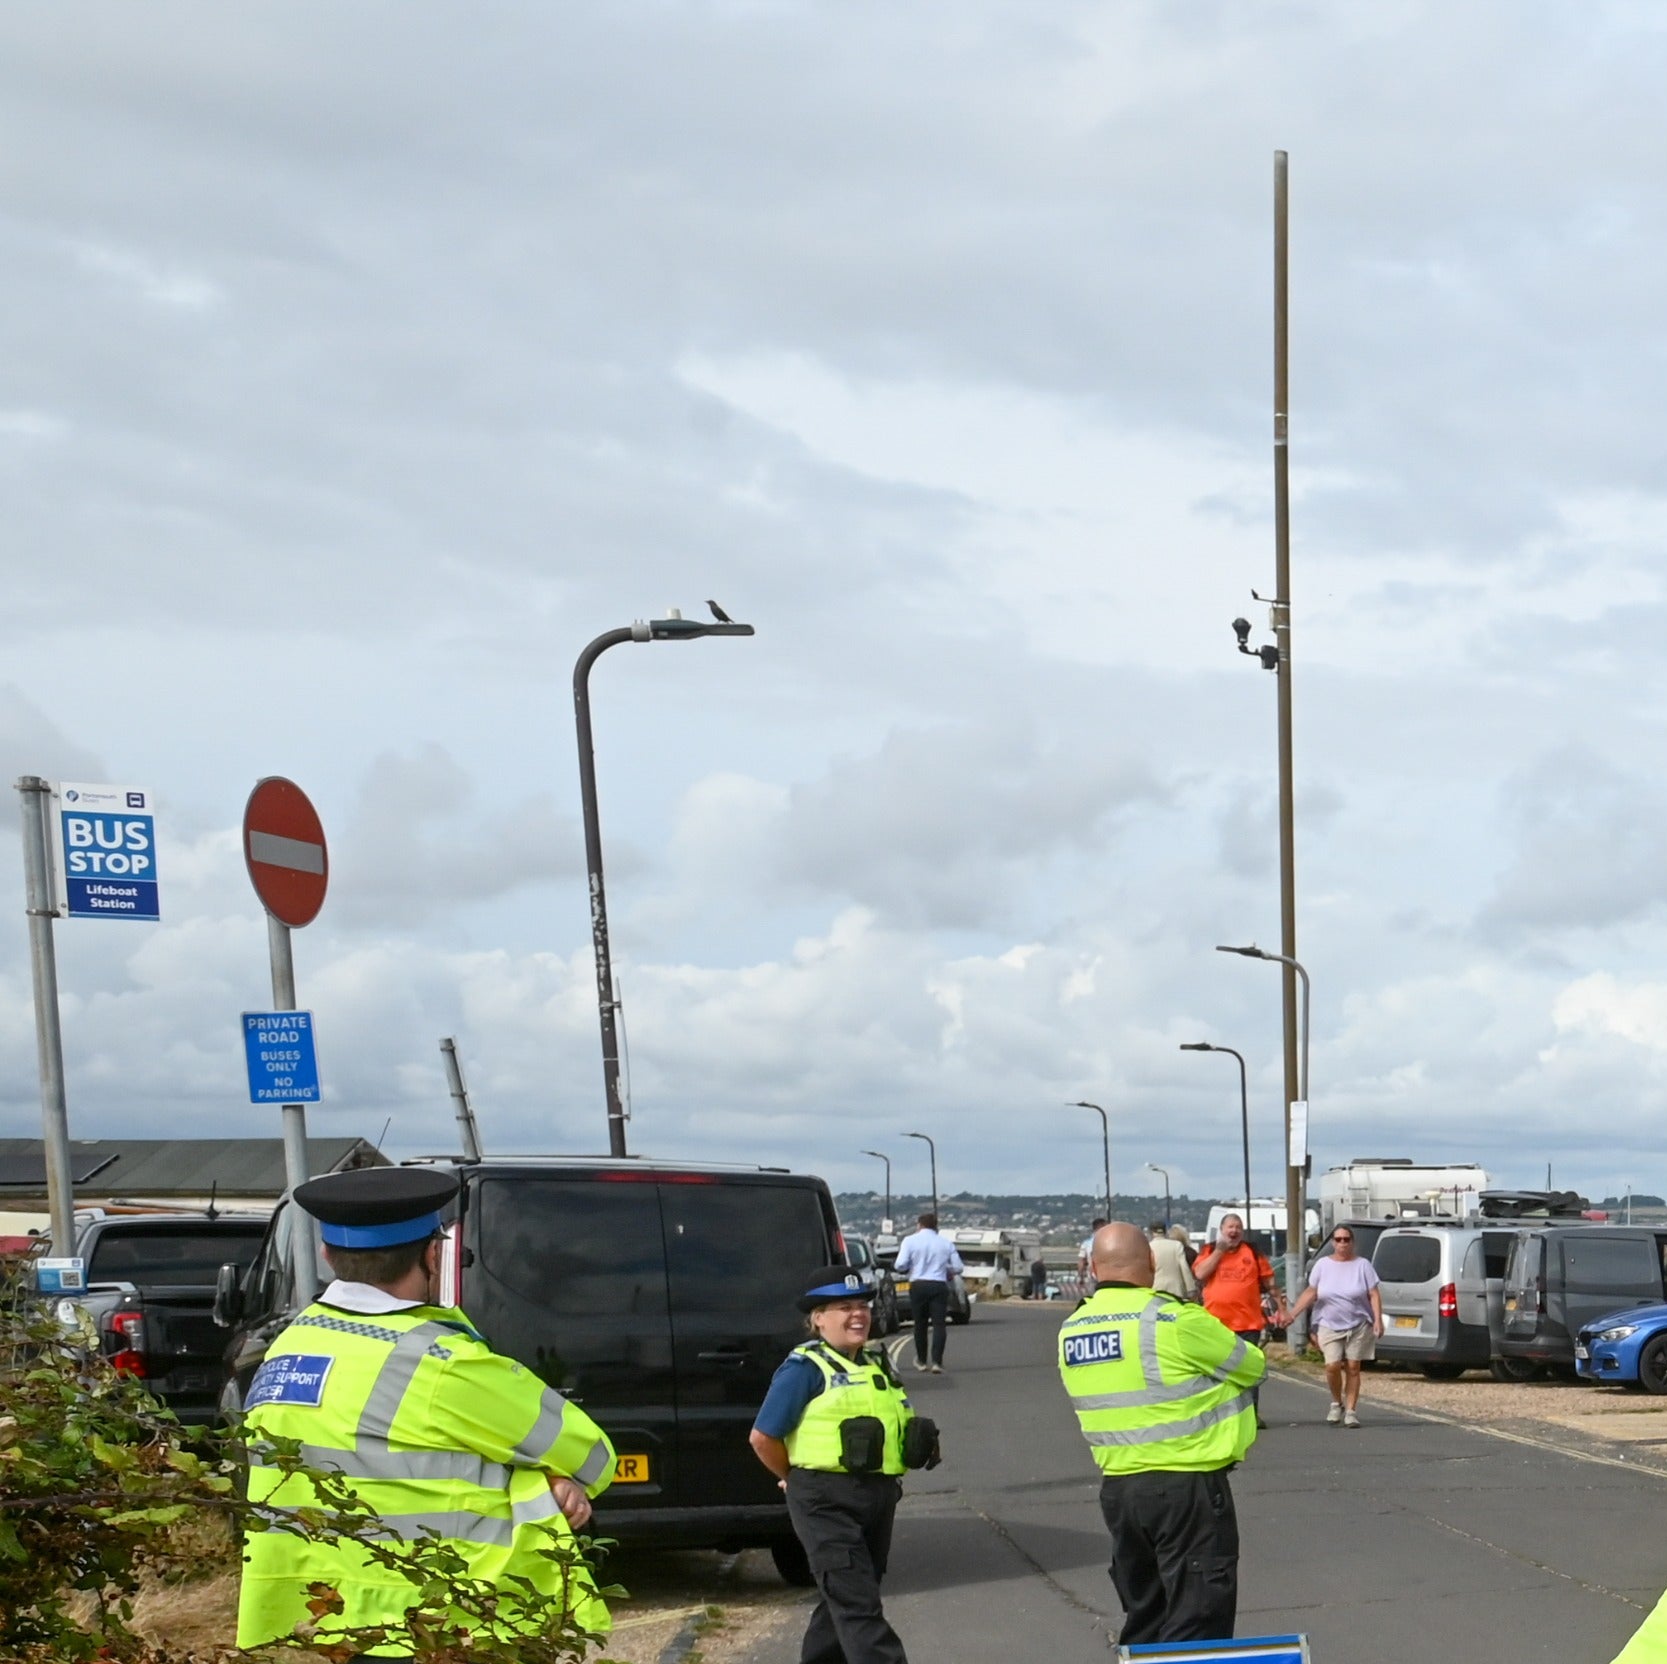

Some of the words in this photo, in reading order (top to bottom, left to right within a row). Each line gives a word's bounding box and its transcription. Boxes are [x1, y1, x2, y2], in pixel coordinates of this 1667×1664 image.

[67, 818, 149, 851] BUS
[69, 850, 150, 875] STOP
[86, 884, 138, 897] Lifeboat
[90, 898, 136, 910] Station
[247, 1016, 308, 1030] PRIVATE
[258, 1031, 300, 1044] ROAD
[260, 1050, 302, 1061] BUSES
[265, 1061, 298, 1073] ONLY
[274, 1076, 294, 1088] NO
[257, 1087, 313, 1099] PARKING
[1064, 1333, 1119, 1362] POLICE
